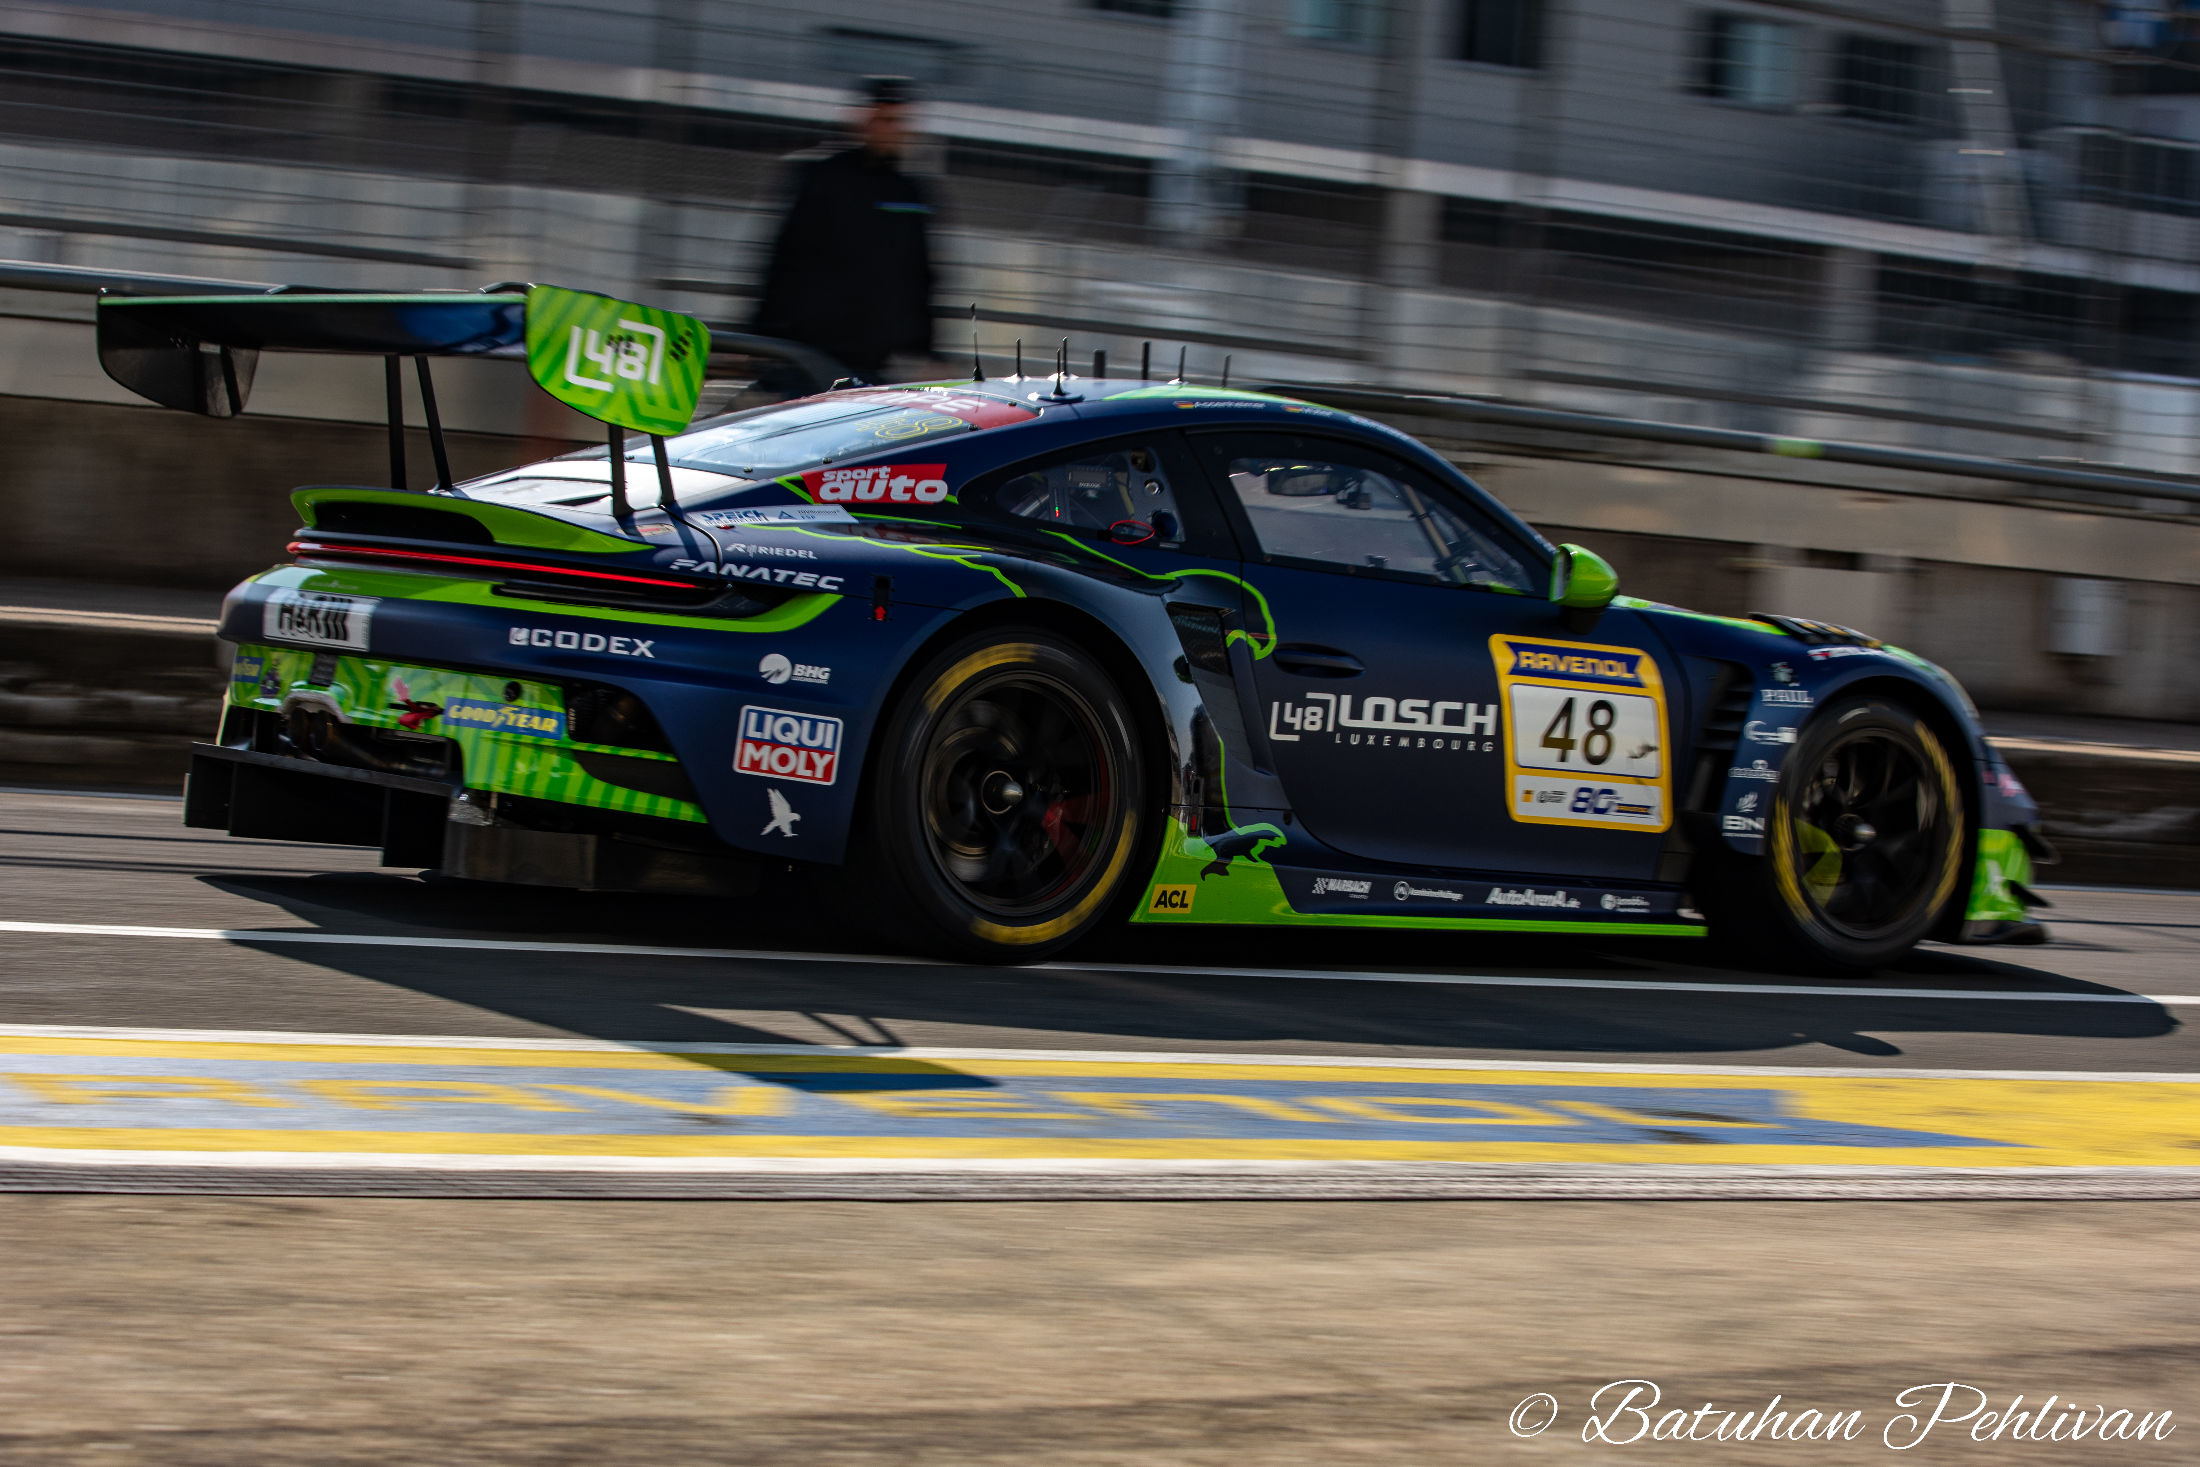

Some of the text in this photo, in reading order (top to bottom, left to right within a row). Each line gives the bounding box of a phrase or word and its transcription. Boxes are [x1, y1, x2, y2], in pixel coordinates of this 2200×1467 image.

[821, 465, 891, 482] sport
[818, 474, 949, 503] auto
[757, 545, 818, 560] RIEDEL
[669, 557, 845, 591] FANATEC
[530, 628, 655, 658] CODEX
[793, 663, 832, 681] BHG
[1516, 651, 1637, 679] RAVENOL
[1338, 694, 1499, 736] LOSCH
[745, 710, 837, 750] LIQUI
[1334, 732, 1495, 753] LUXEMBOURG
[1539, 696, 1617, 766] 48
[740, 741, 835, 779] MOLY
[1153, 889, 1189, 909] ACL
